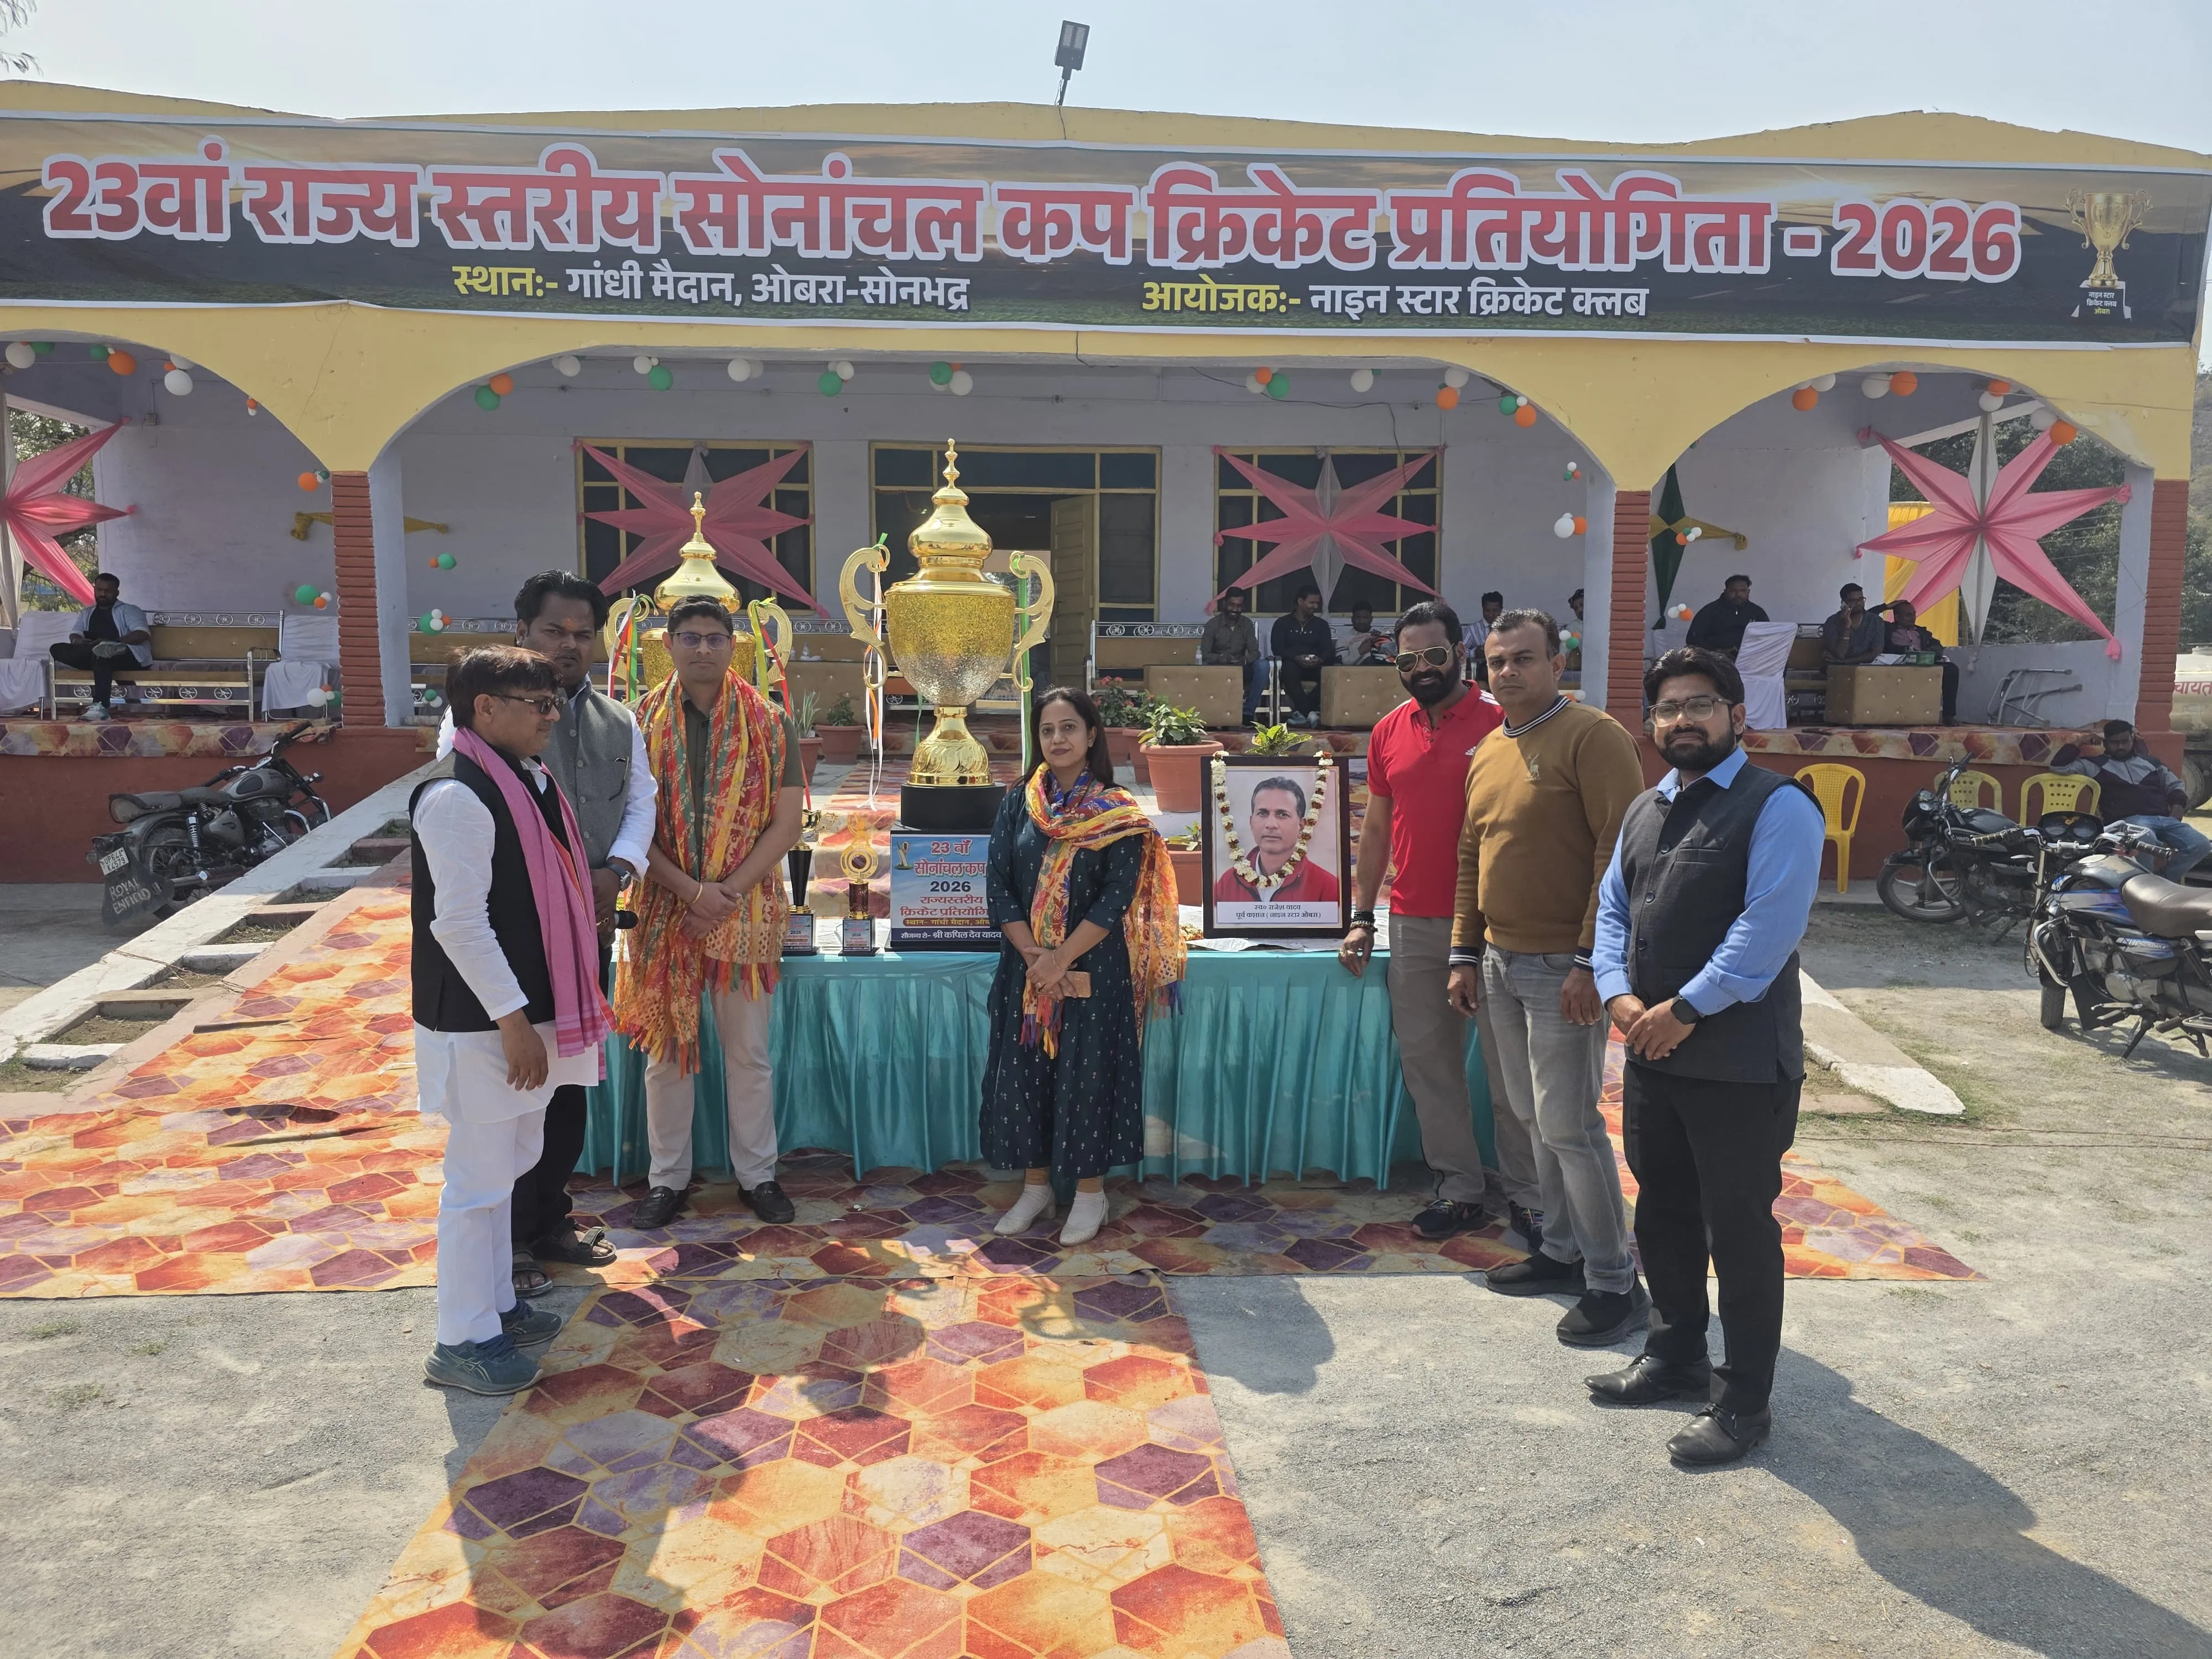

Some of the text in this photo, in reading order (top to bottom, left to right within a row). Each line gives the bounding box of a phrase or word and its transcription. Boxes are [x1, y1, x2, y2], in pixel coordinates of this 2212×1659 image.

[45, 139, 231, 238] 23वां
[242, 164, 419, 242] राज्य
[430, 146, 662, 249] स्तरीय
[672, 153, 985, 257] सोनांचल
[994, 185, 1135, 262] कप
[1144, 166, 1380, 266] क्रिकेट
[1387, 171, 1774, 270] प्रतियोगिता
[1834, 200, 2020, 279] 2026
[565, 259, 644, 300] गांधी
[649, 258, 743, 306] मैदान,
[751, 263, 971, 310] ओबरा-सोनभद्र
[1308, 285, 1390, 320] नाइन
[1395, 285, 1462, 314] स्टार
[1467, 276, 1566, 315] क्रिकेट
[1571, 287, 1650, 316] क्लब
[2086, 298, 2103, 306] क्रिकेट
[2174, 681, 2212, 697] चायत
[931, 841, 951, 854] 23
[914, 858, 987, 877] सोनांचल कप
[109, 878, 139, 902] ROYAL
[930, 881, 972, 893] 2026
[112, 888, 151, 914] ENFIELD
[920, 894, 984, 904] राज्यस्तरीय
[900, 906, 938, 916] क्रिकेट
[932, 930, 943, 938] श्री
[944, 930, 968, 938] कपिल
